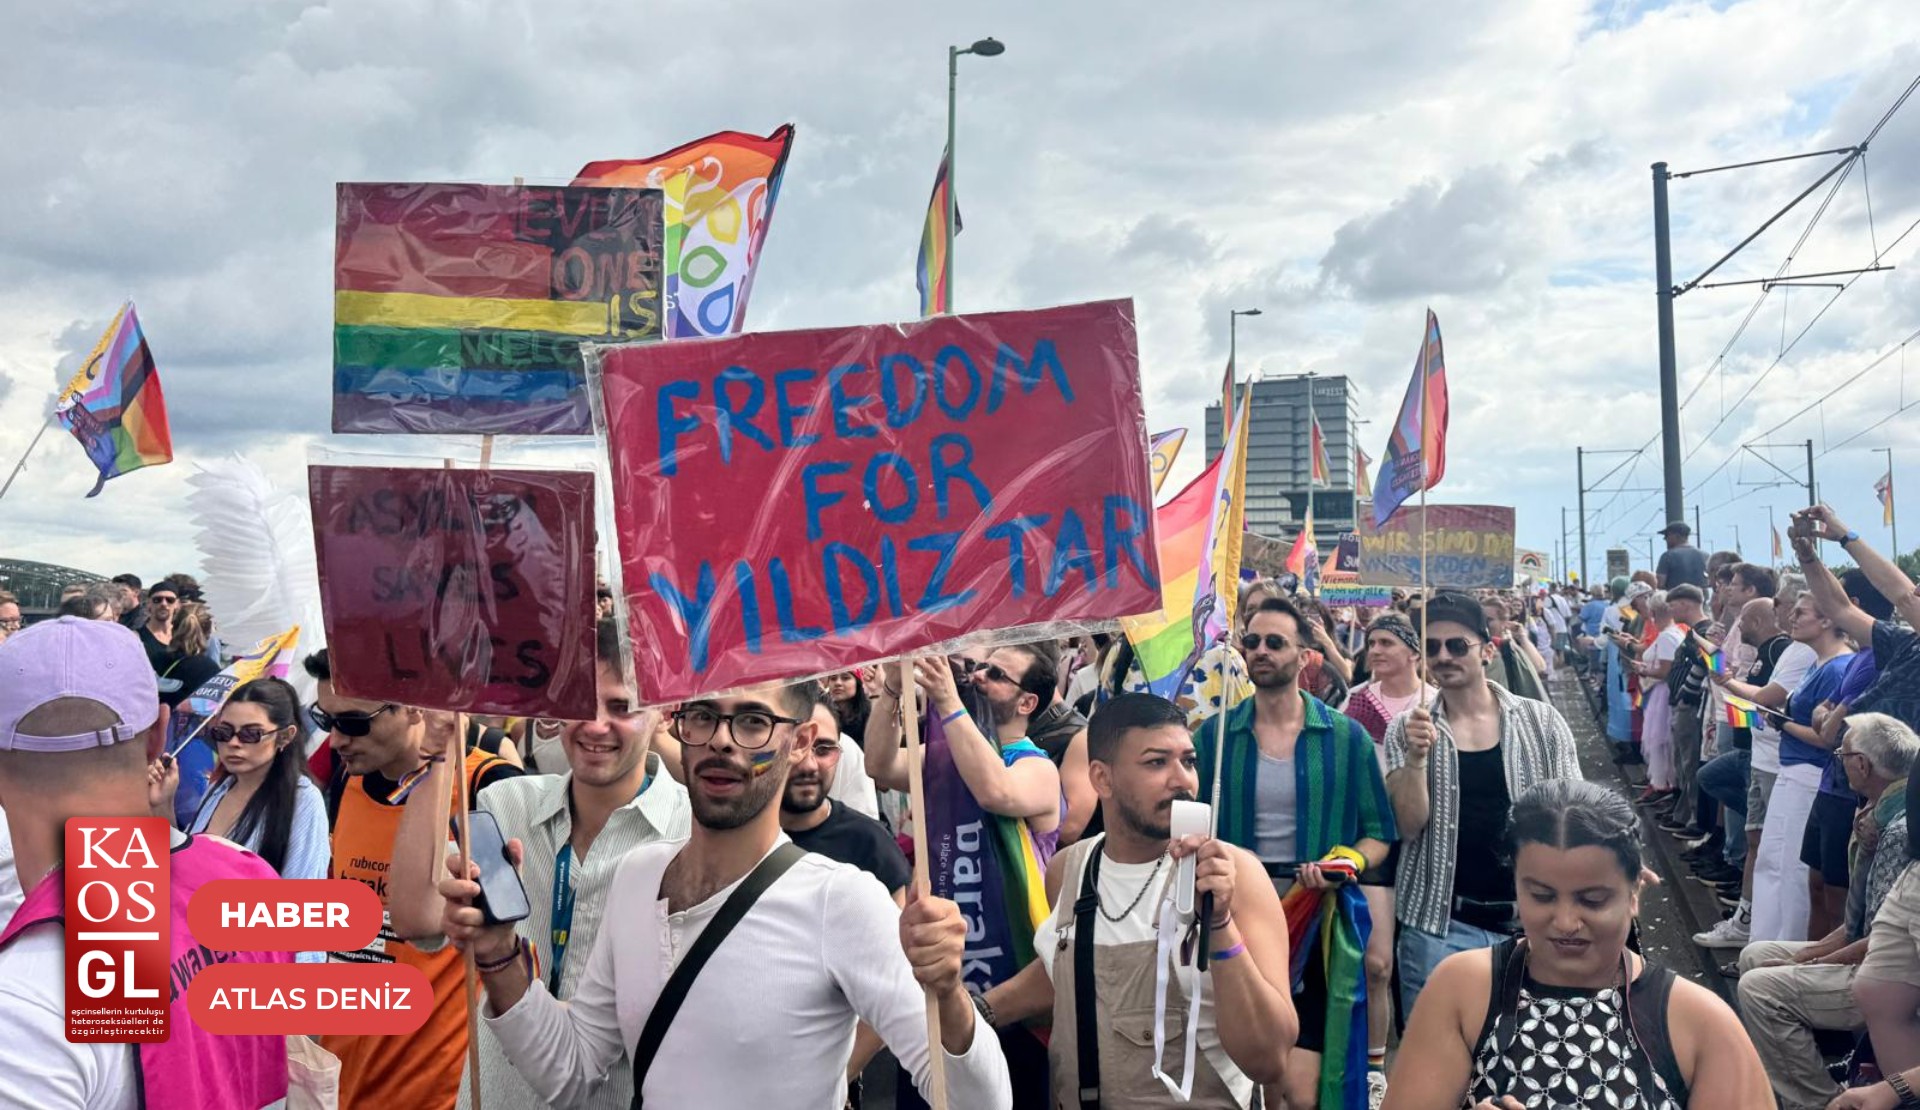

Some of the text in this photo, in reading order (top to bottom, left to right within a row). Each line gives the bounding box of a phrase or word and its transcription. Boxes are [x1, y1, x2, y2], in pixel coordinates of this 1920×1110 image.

[553, 246, 658, 300] ONE
[609, 290, 657, 338] IS
[462, 331, 581, 365] WELC
[657, 339, 1075, 476] FREEDOM
[802, 433, 993, 541] FOR
[1362, 531, 1411, 552] WIR
[1418, 527, 1477, 553] SIND
[649, 495, 1159, 672] YILDIZ TAR
[940, 842, 951, 869] place
